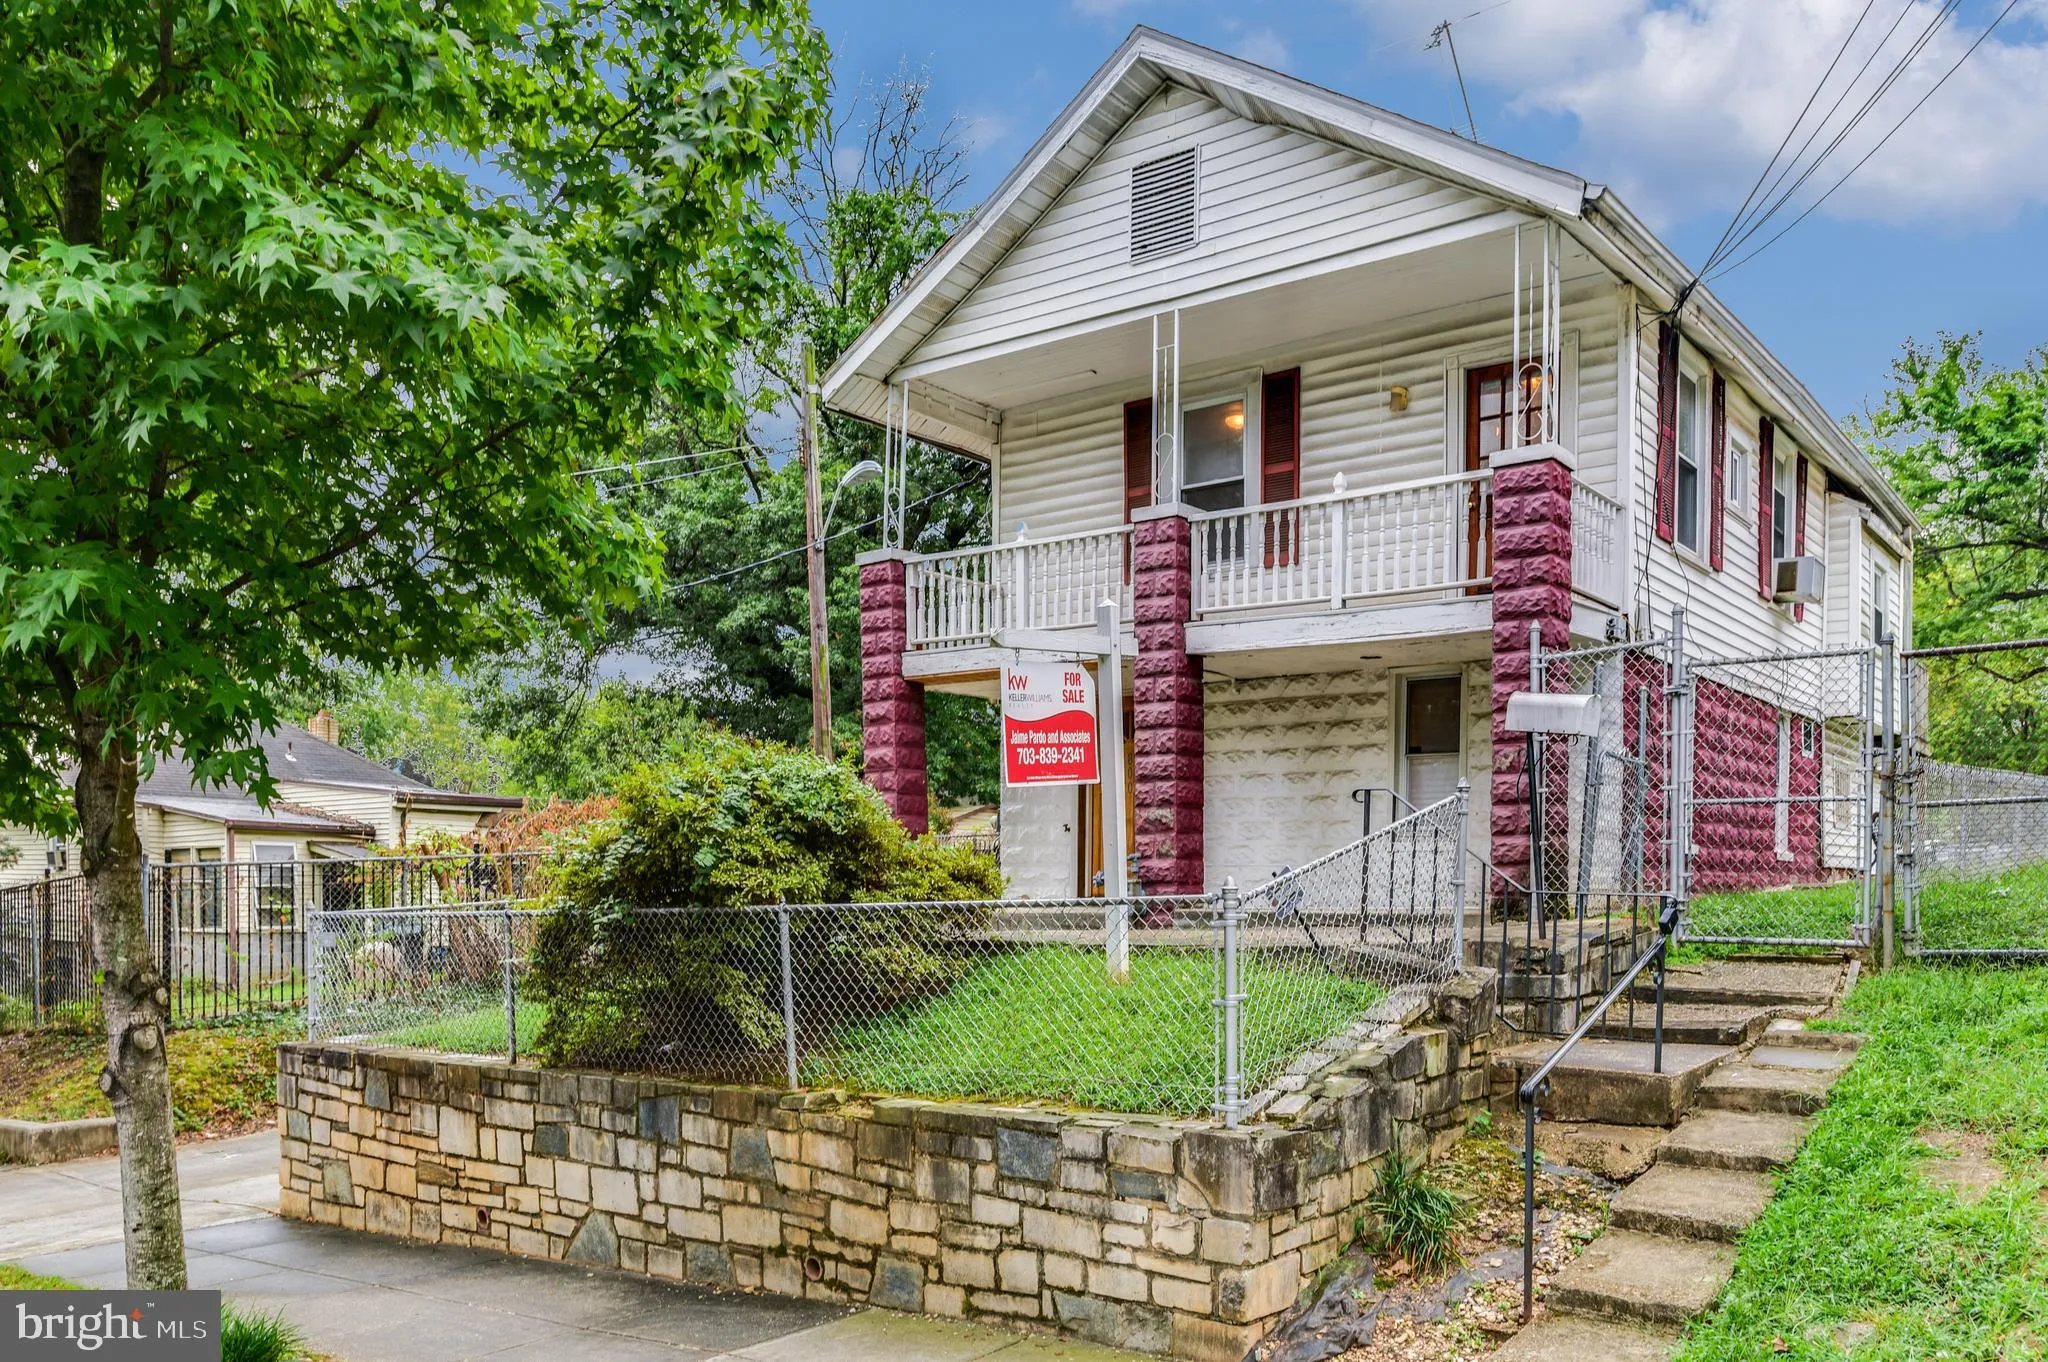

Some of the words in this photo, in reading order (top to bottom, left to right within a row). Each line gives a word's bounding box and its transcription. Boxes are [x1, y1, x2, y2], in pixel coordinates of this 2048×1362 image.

[1065, 672, 1081, 686] FOR
[1062, 690, 1084, 703] SALE
[1011, 731, 1028, 744] Jaime
[1030, 730, 1046, 744] Pardo
[1048, 730, 1058, 743] and
[1060, 730, 1090, 743] Associates
[1017, 747, 1084, 764] 703-839-2341
